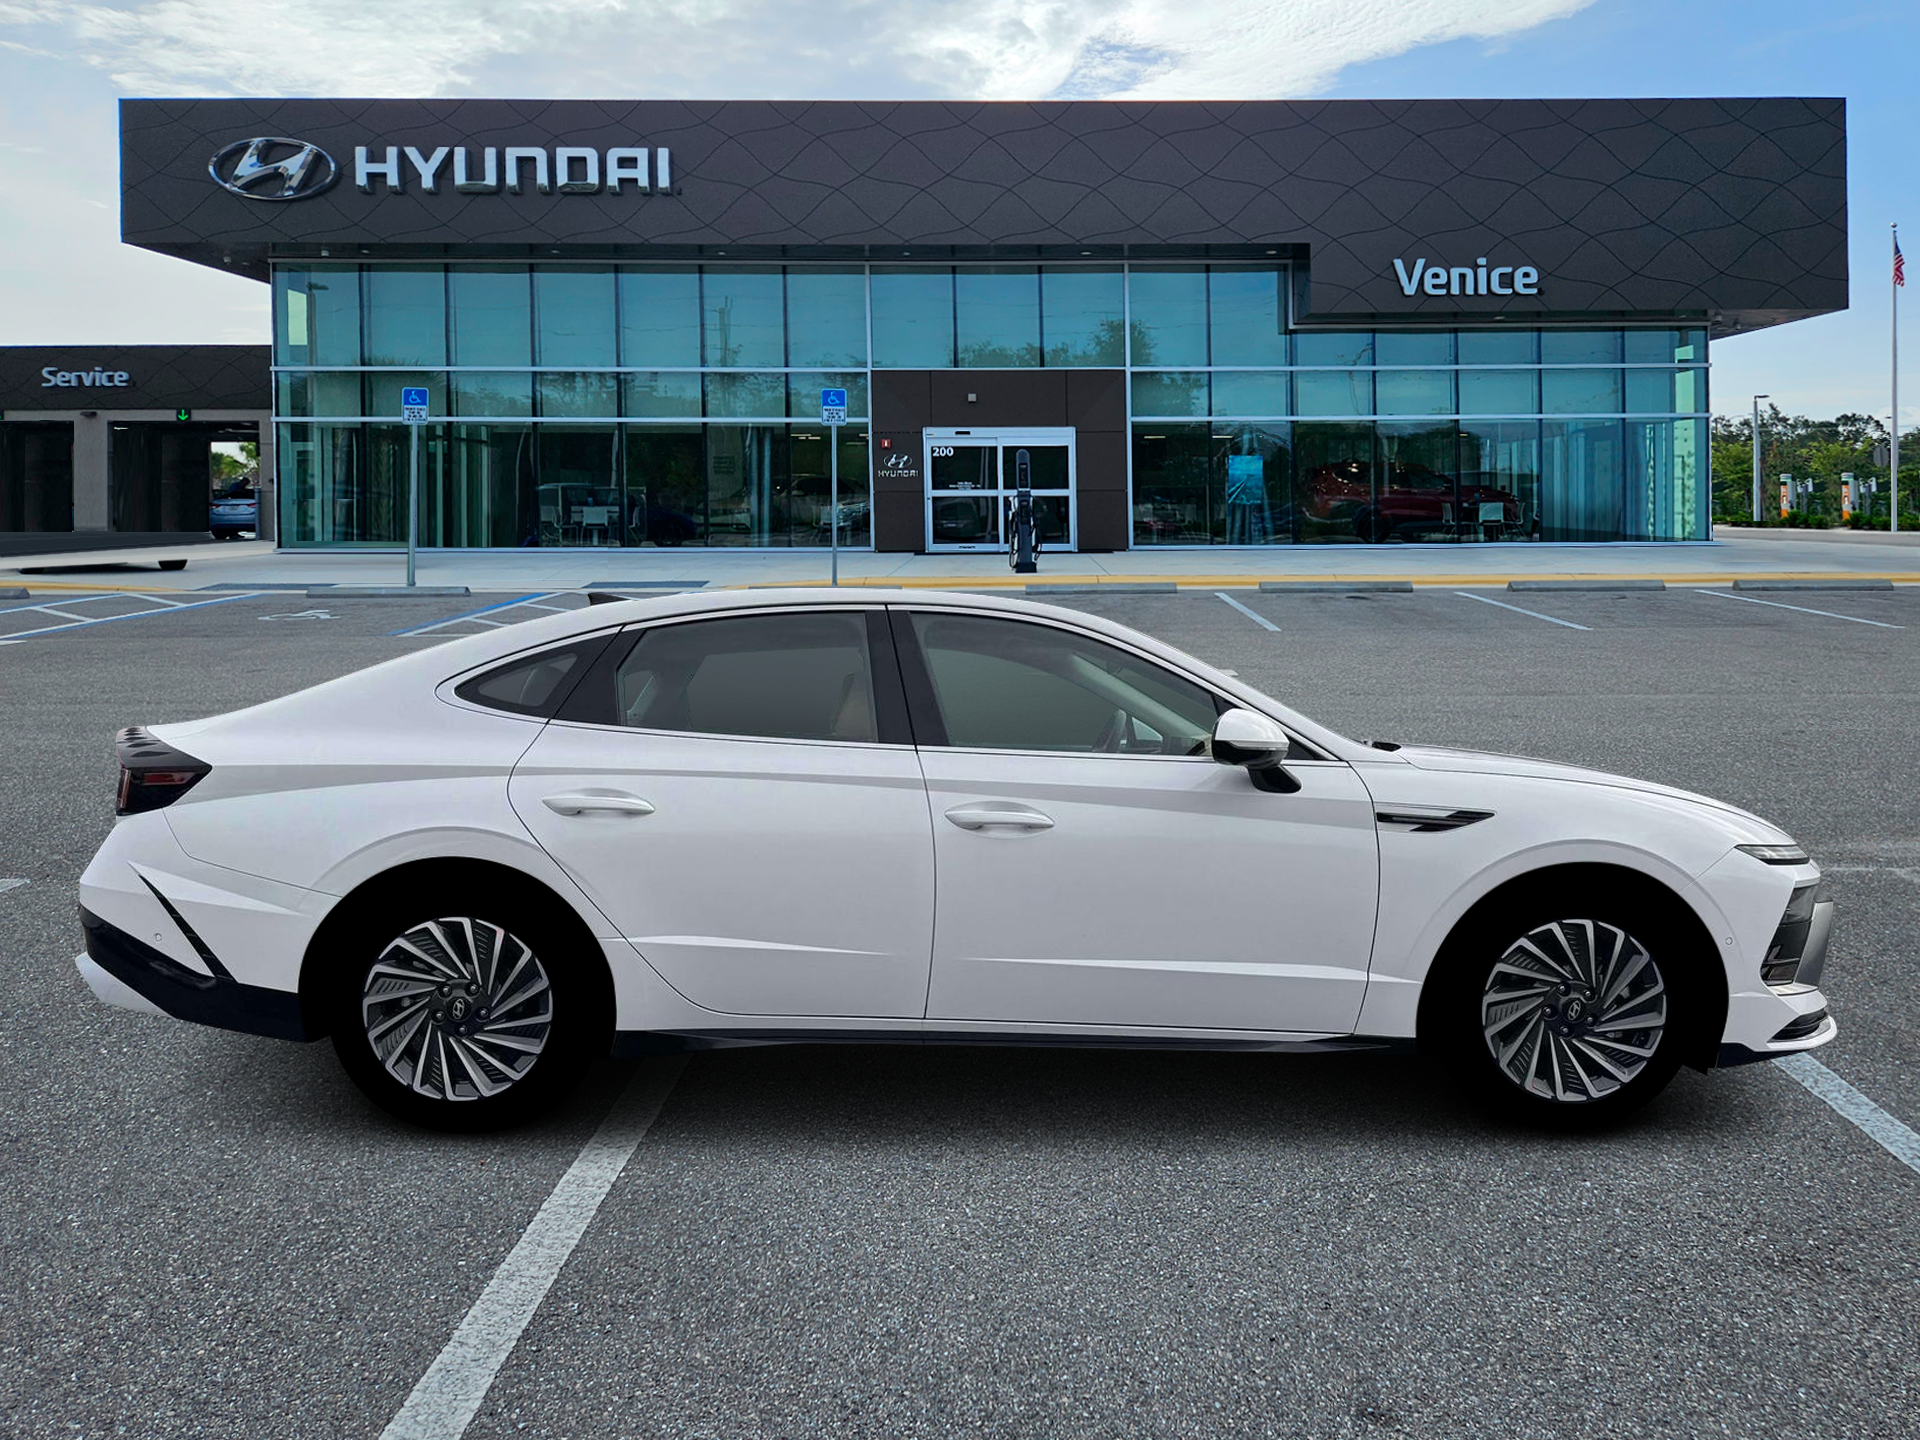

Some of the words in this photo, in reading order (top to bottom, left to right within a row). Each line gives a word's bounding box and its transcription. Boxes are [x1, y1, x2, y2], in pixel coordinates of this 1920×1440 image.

[354, 146, 672, 194] HYUNDAI
[1393, 257, 1539, 296] Venice
[41, 366, 130, 388] Service
[932, 447, 954, 457] 200
[878, 469, 919, 478] HYUNDAI
